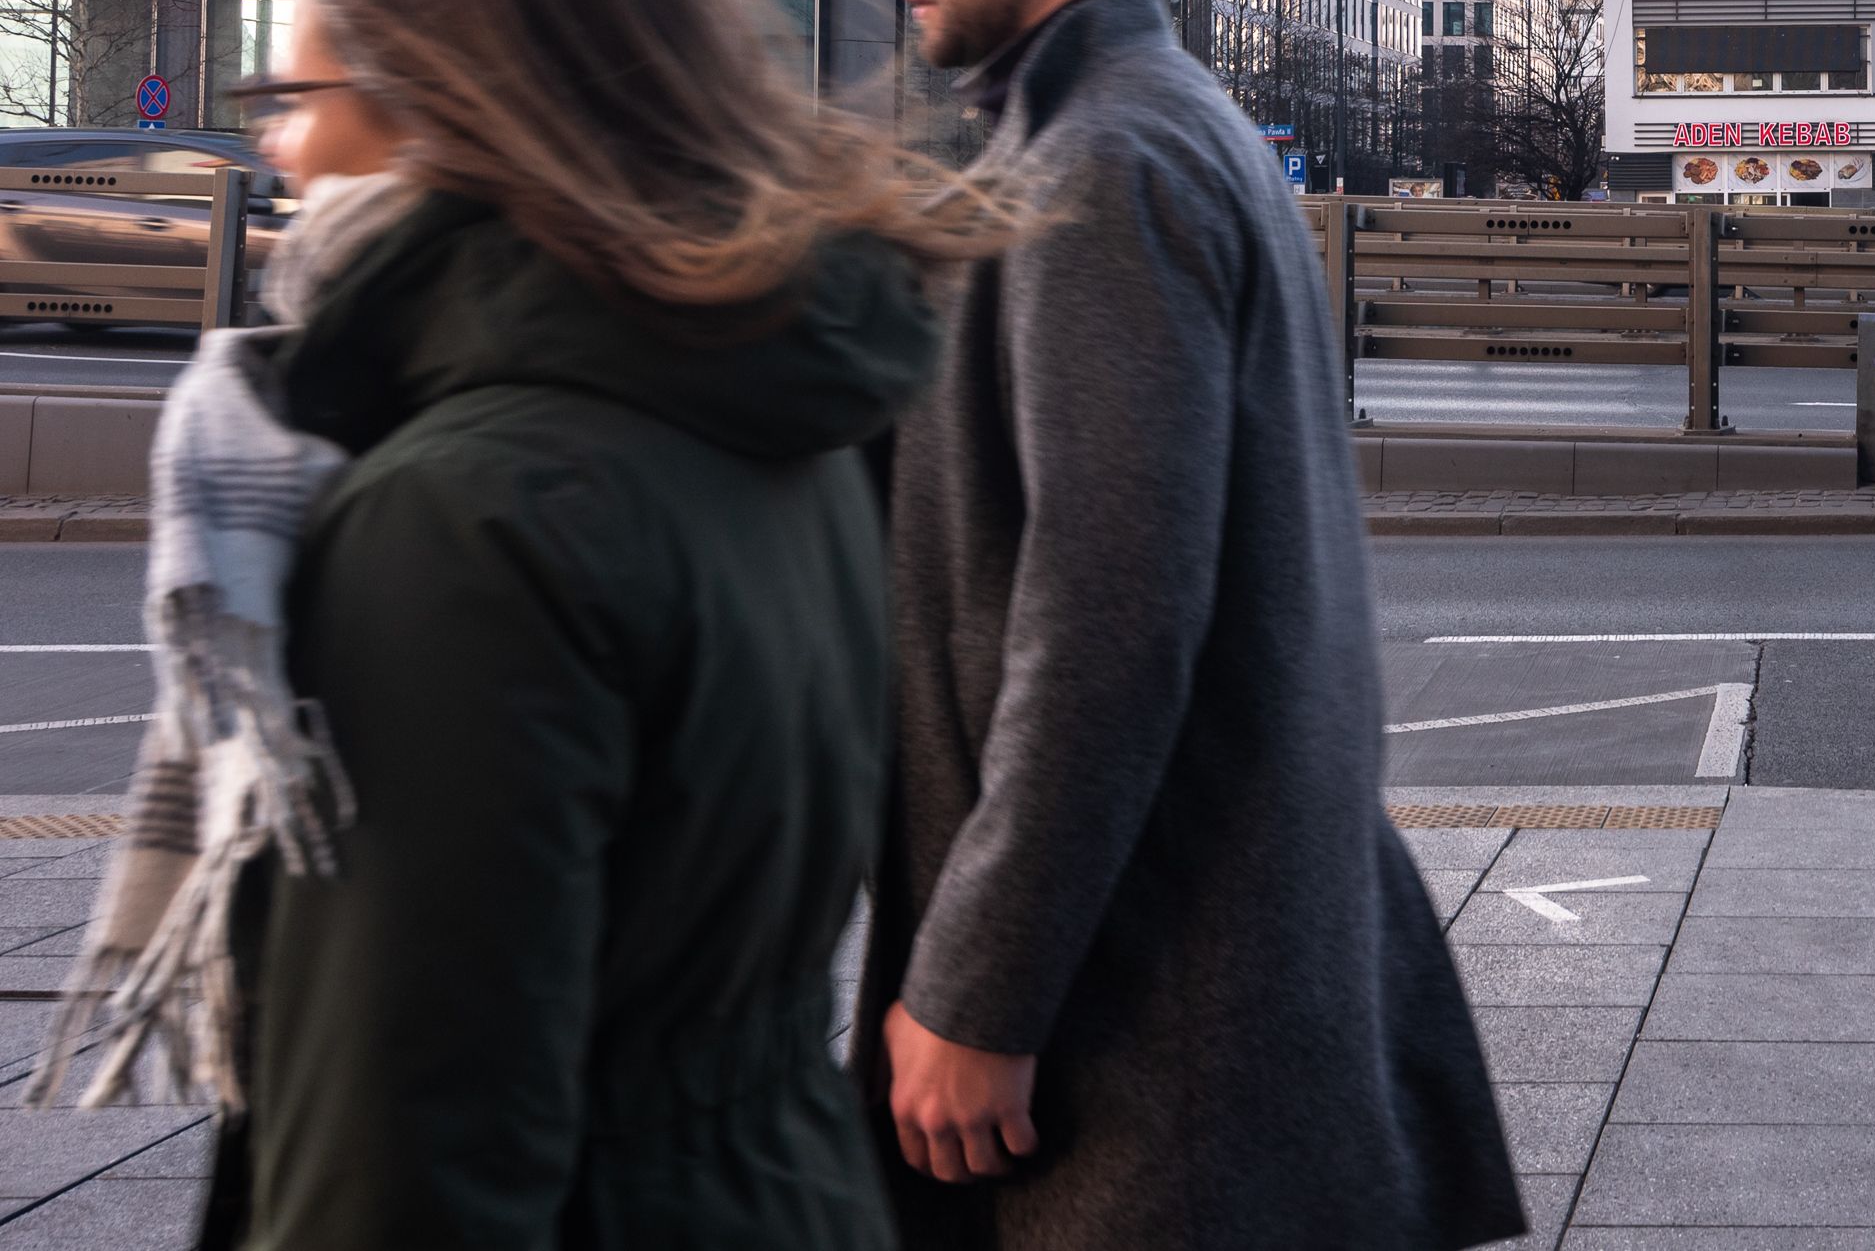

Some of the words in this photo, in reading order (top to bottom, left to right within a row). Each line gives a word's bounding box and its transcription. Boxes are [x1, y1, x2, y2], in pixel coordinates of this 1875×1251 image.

[1673, 123, 1741, 147] ADEN
[1758, 122, 1851, 146] KEBAB
[1289, 157, 1301, 176] P
